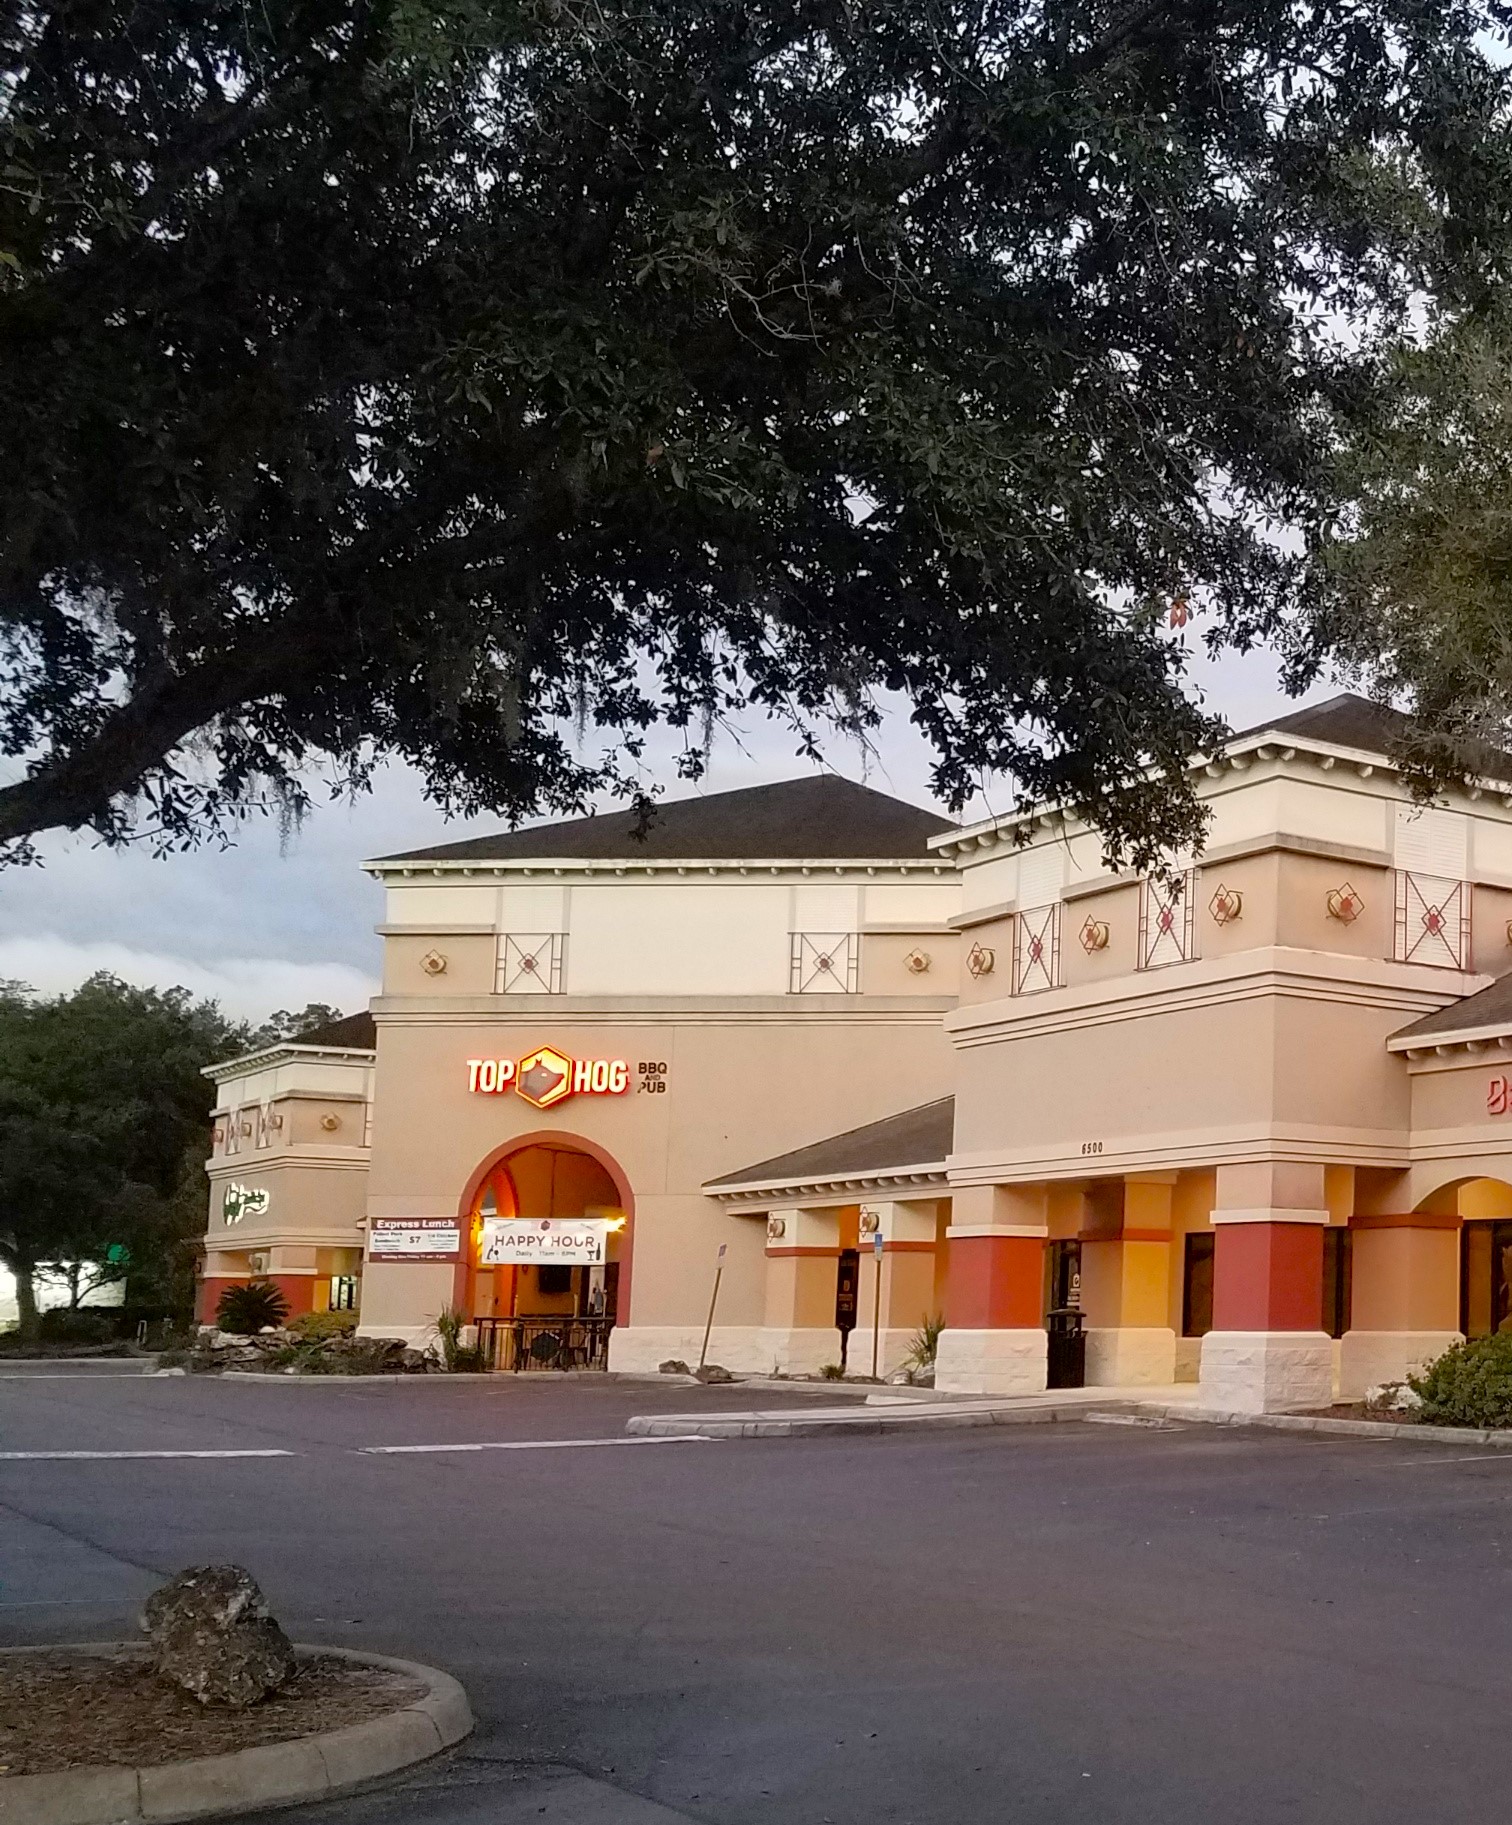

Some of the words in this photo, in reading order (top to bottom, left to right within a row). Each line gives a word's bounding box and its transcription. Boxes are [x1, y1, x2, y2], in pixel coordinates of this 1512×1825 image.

[638, 1062, 667, 1074] BBQ
[467, 1059, 514, 1093] TOP
[574, 1060, 629, 1093] HOG
[637, 1081, 666, 1093] PUB
[1081, 1142, 1103, 1155] 6500
[377, 1220, 420, 1229] Express
[422, 1219, 455, 1228] Lunch
[494, 1235, 546, 1246] HAPPY
[551, 1236, 595, 1247] HOUR
